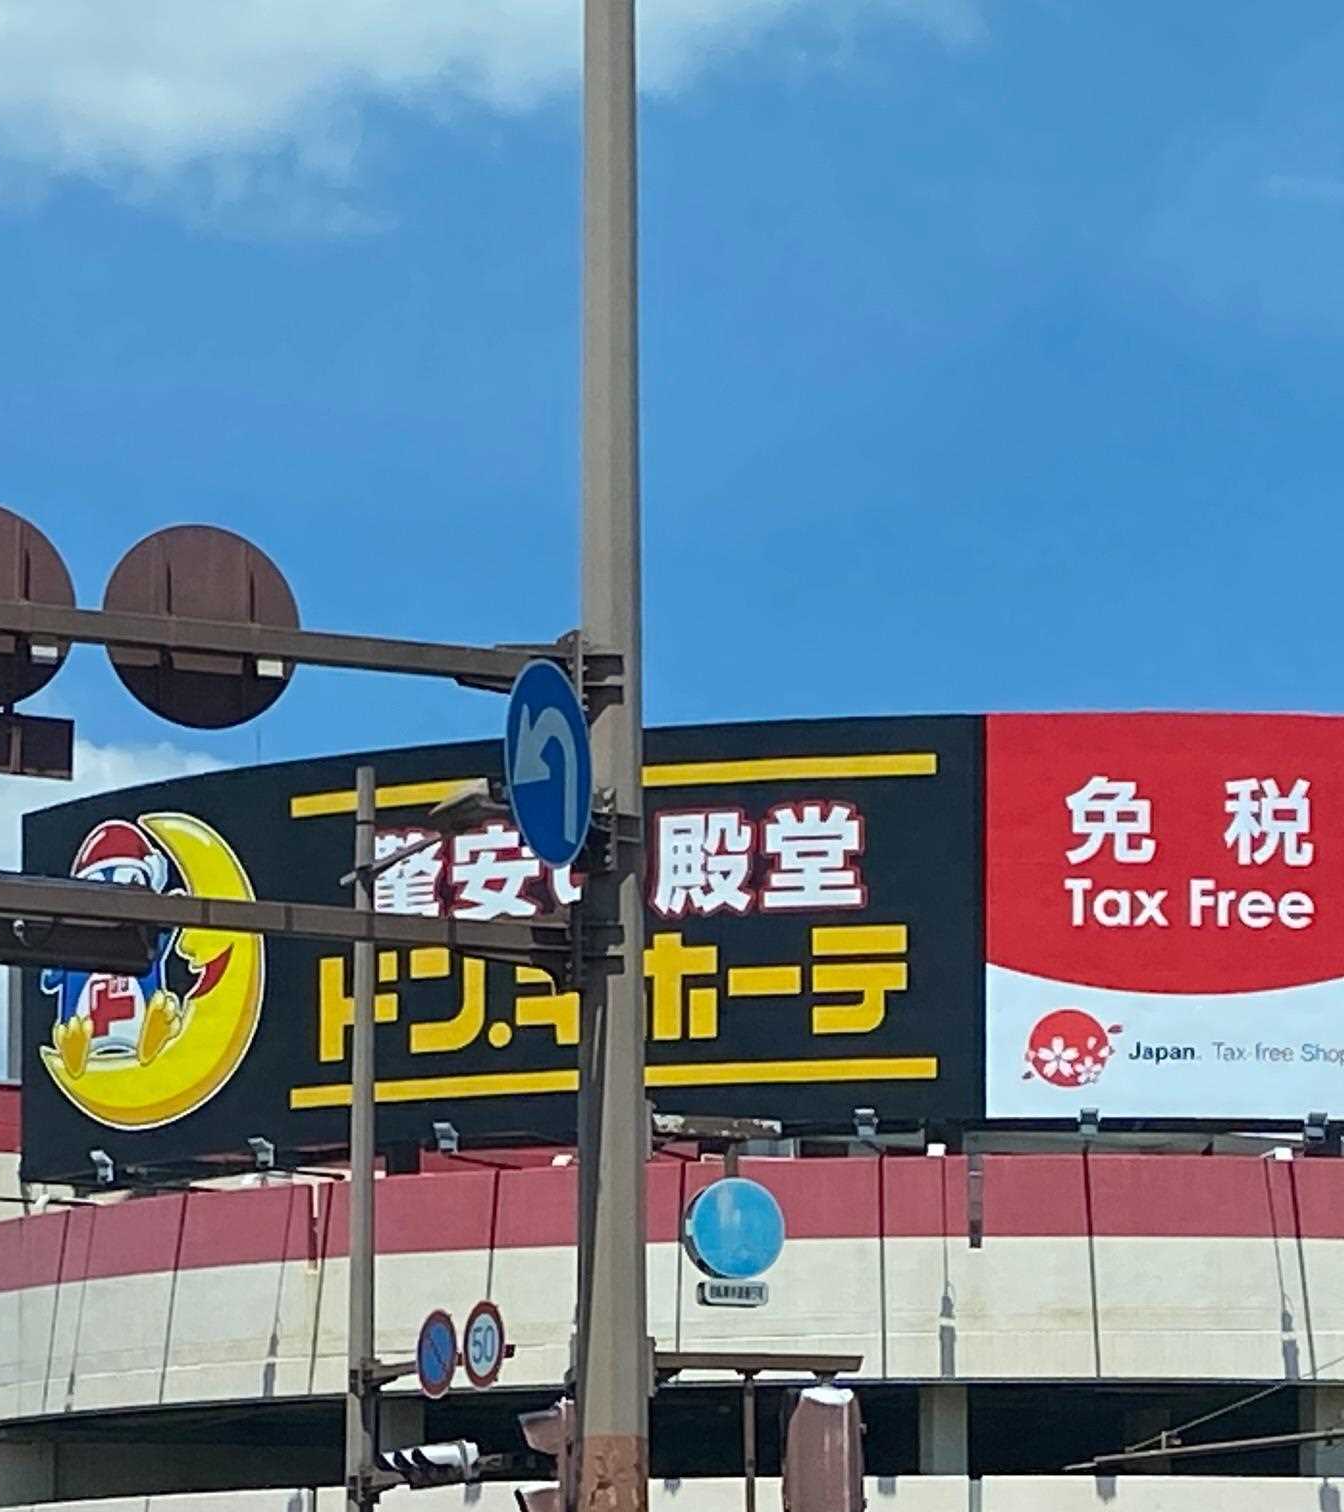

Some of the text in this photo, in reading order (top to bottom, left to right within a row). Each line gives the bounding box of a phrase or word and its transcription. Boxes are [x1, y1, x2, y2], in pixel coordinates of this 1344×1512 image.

[1065, 775, 1314, 866] 免税
[369, 803, 864, 920] 驚安殿堂
[1064, 878, 1315, 929] Tax Free
[472, 1324, 495, 1364] 50
